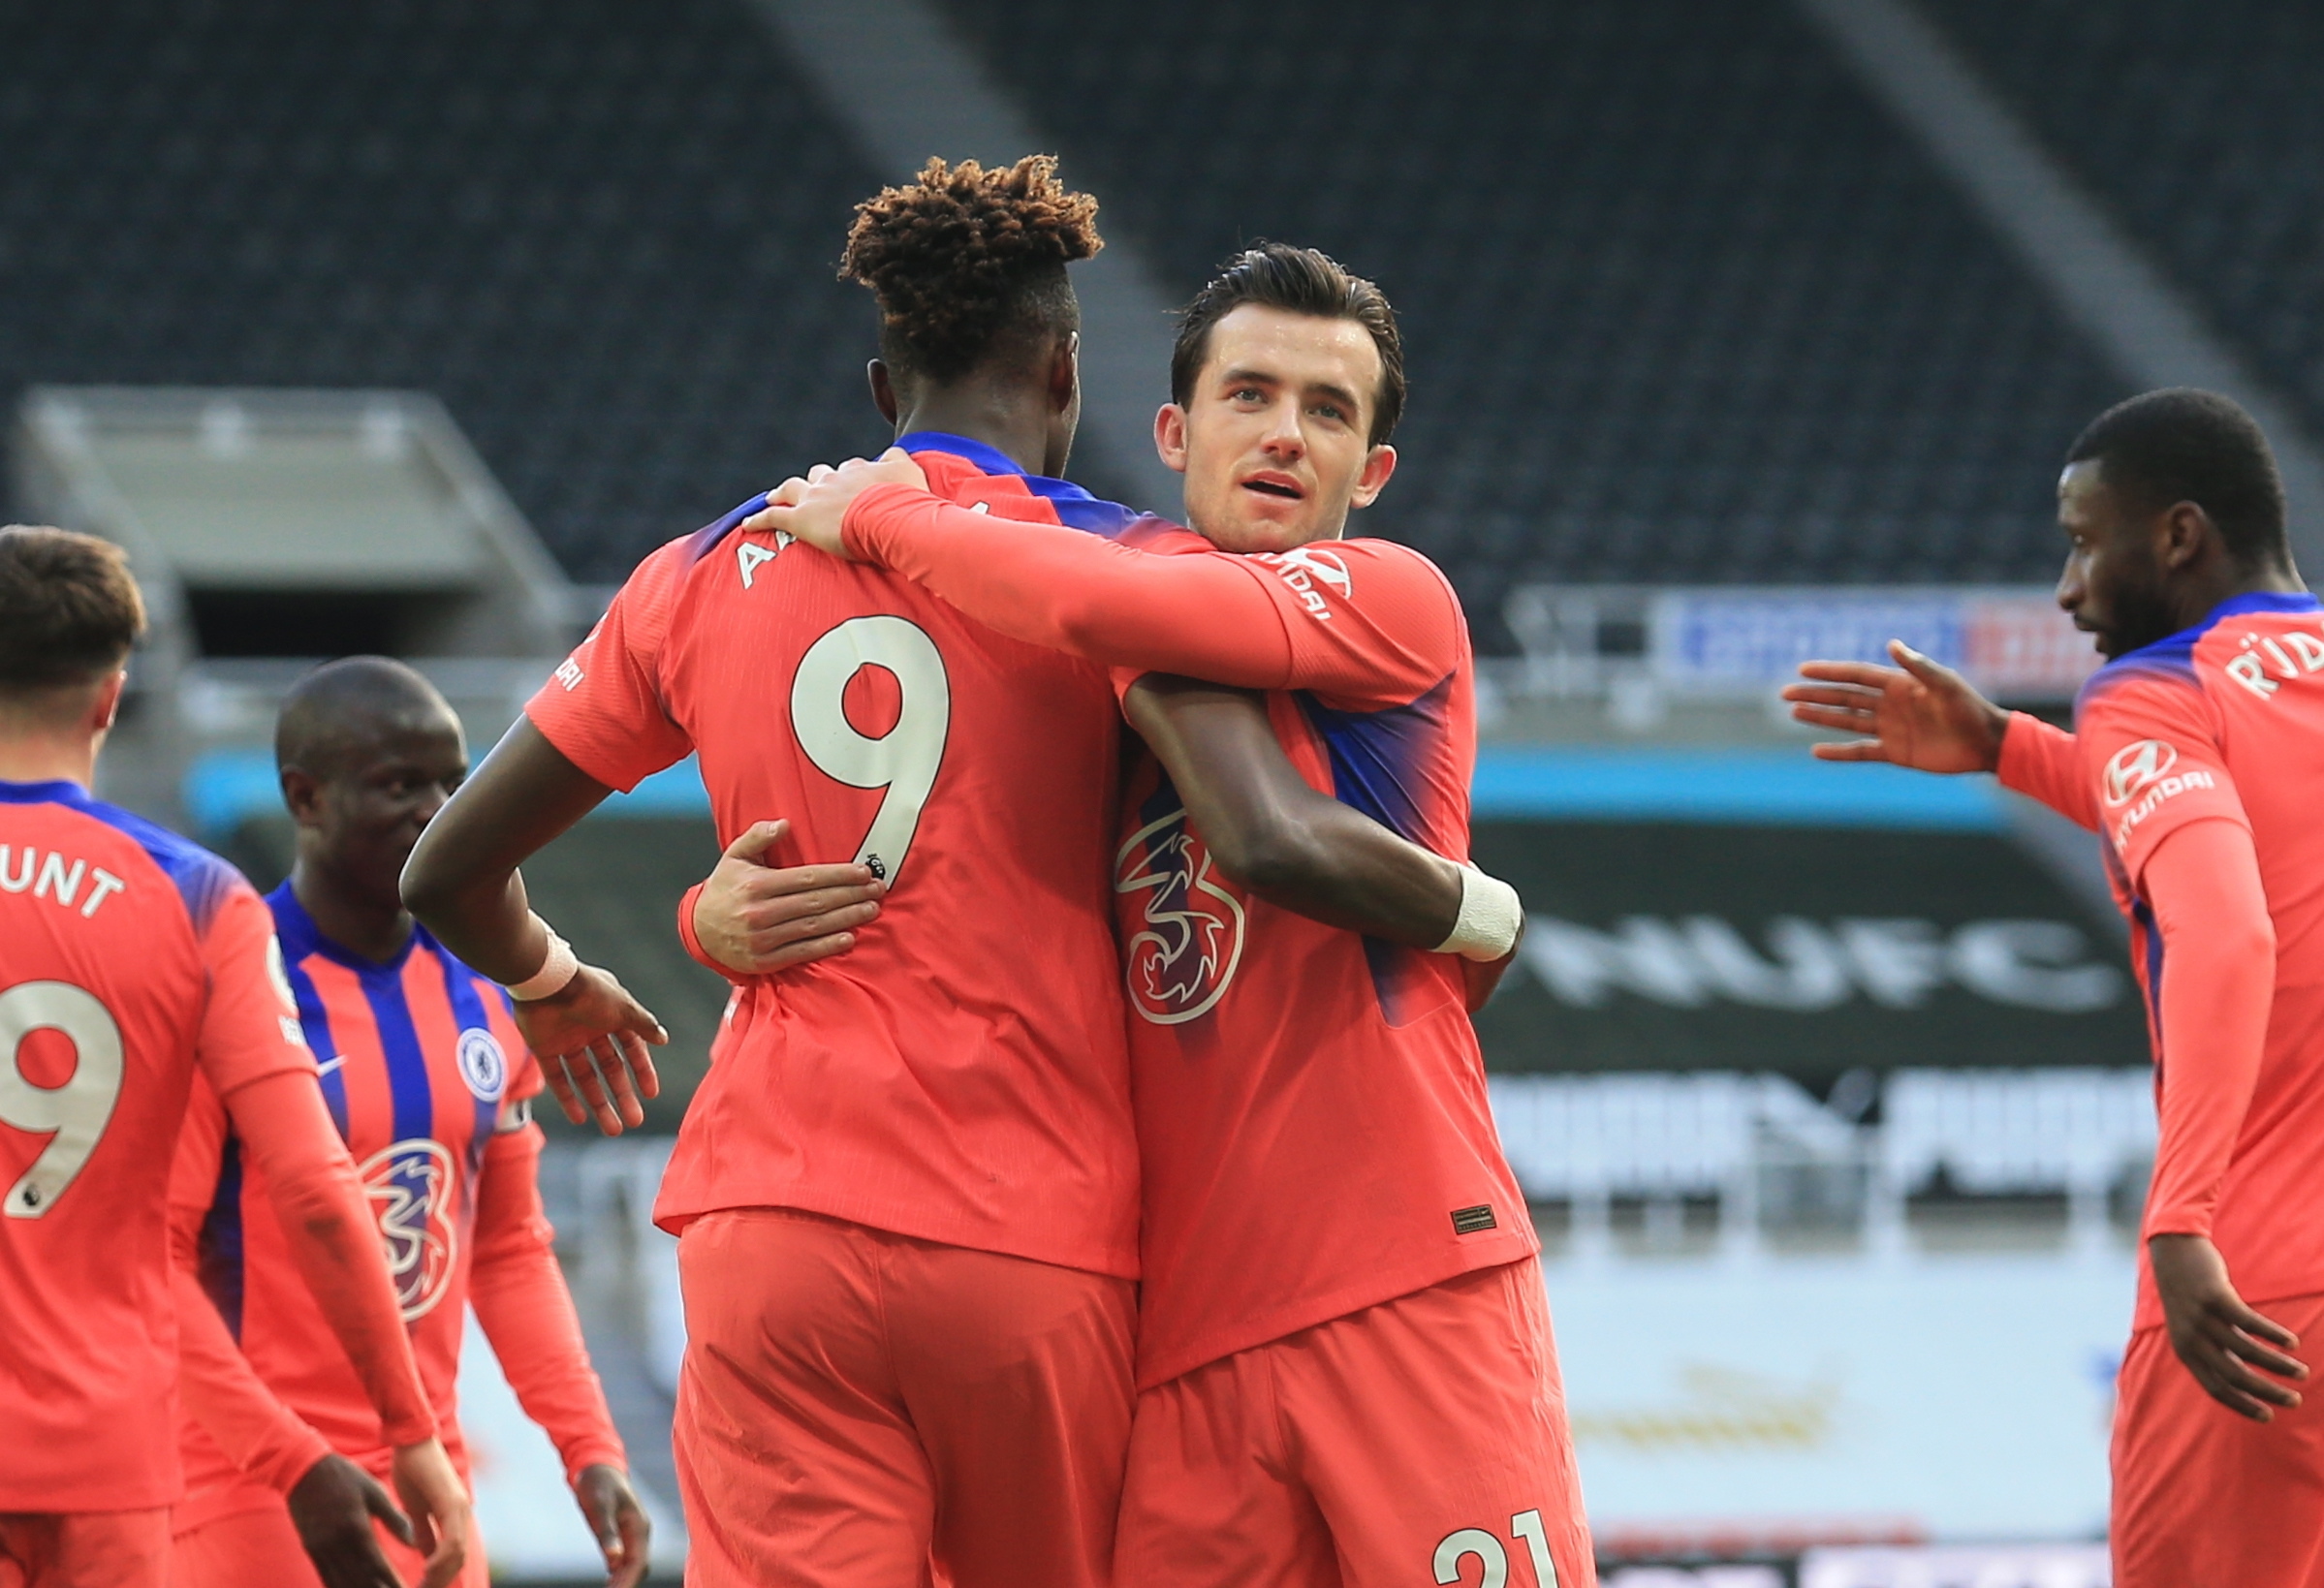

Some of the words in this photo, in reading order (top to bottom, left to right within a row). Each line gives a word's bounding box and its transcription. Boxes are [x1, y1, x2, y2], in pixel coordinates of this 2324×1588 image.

[2225, 622, 2324, 701] RÜD
[790, 615, 951, 890] 9
[1518, 913, 2124, 1013] NUFC
[0, 979, 126, 1220] 9
[1431, 1508, 1559, 1588] 21
